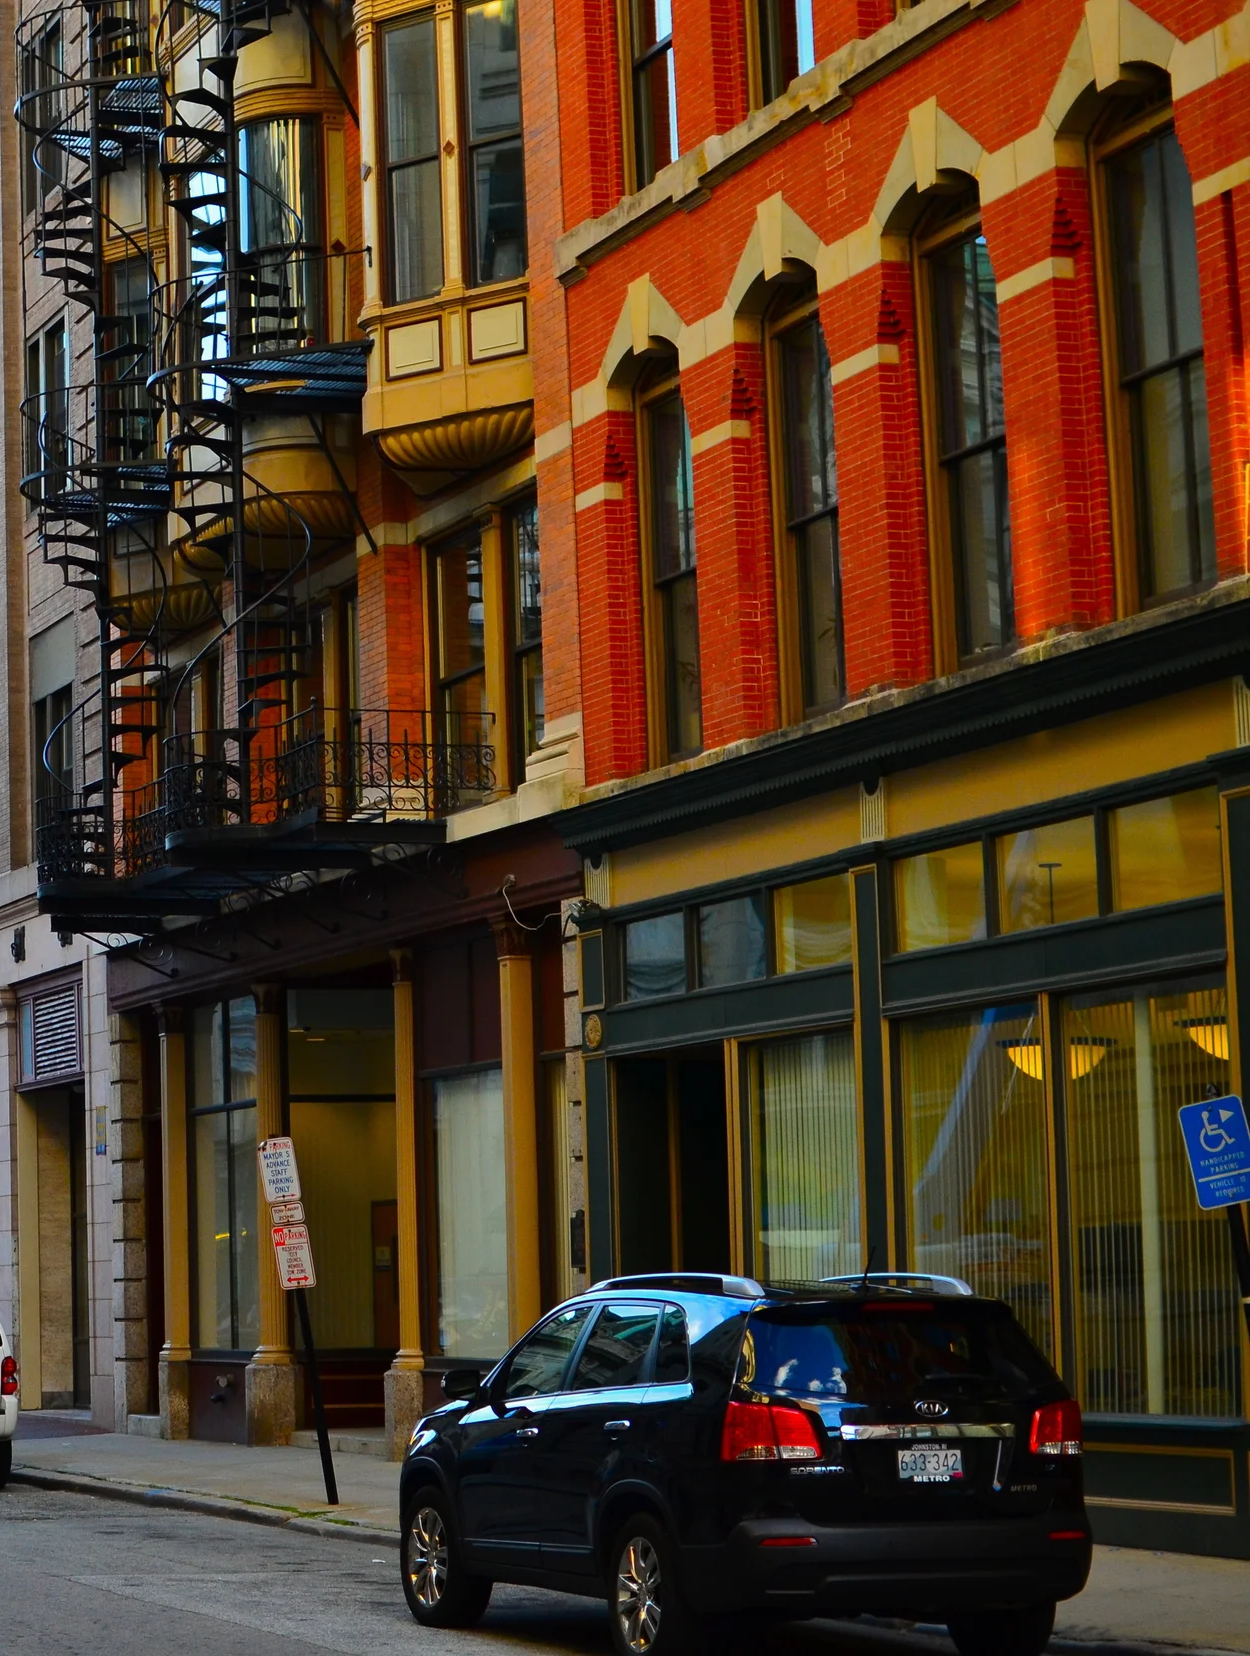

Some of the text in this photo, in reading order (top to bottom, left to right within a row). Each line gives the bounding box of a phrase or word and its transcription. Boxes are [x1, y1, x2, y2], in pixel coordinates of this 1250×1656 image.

[263, 1152, 283, 1160] MAYOR
[1200, 1151, 1245, 1167] HANDICAPPED
[266, 1160, 290, 1169] ADVANCE
[1210, 1161, 1239, 1174] PARKING
[271, 1169, 287, 1177] STAFF
[268, 1177, 294, 1186] PARKING
[1210, 1178, 1235, 1189] VEHICLE
[274, 1186, 290, 1194] ONLY
[1215, 1185, 1245, 1197] REQUIRED
[274, 1231, 306, 1244] NO PARKING
[282, 1244, 304, 1252] RESERVED
[900, 1453, 959, 1471] 633-342
[790, 1466, 845, 1474] SORENTO
